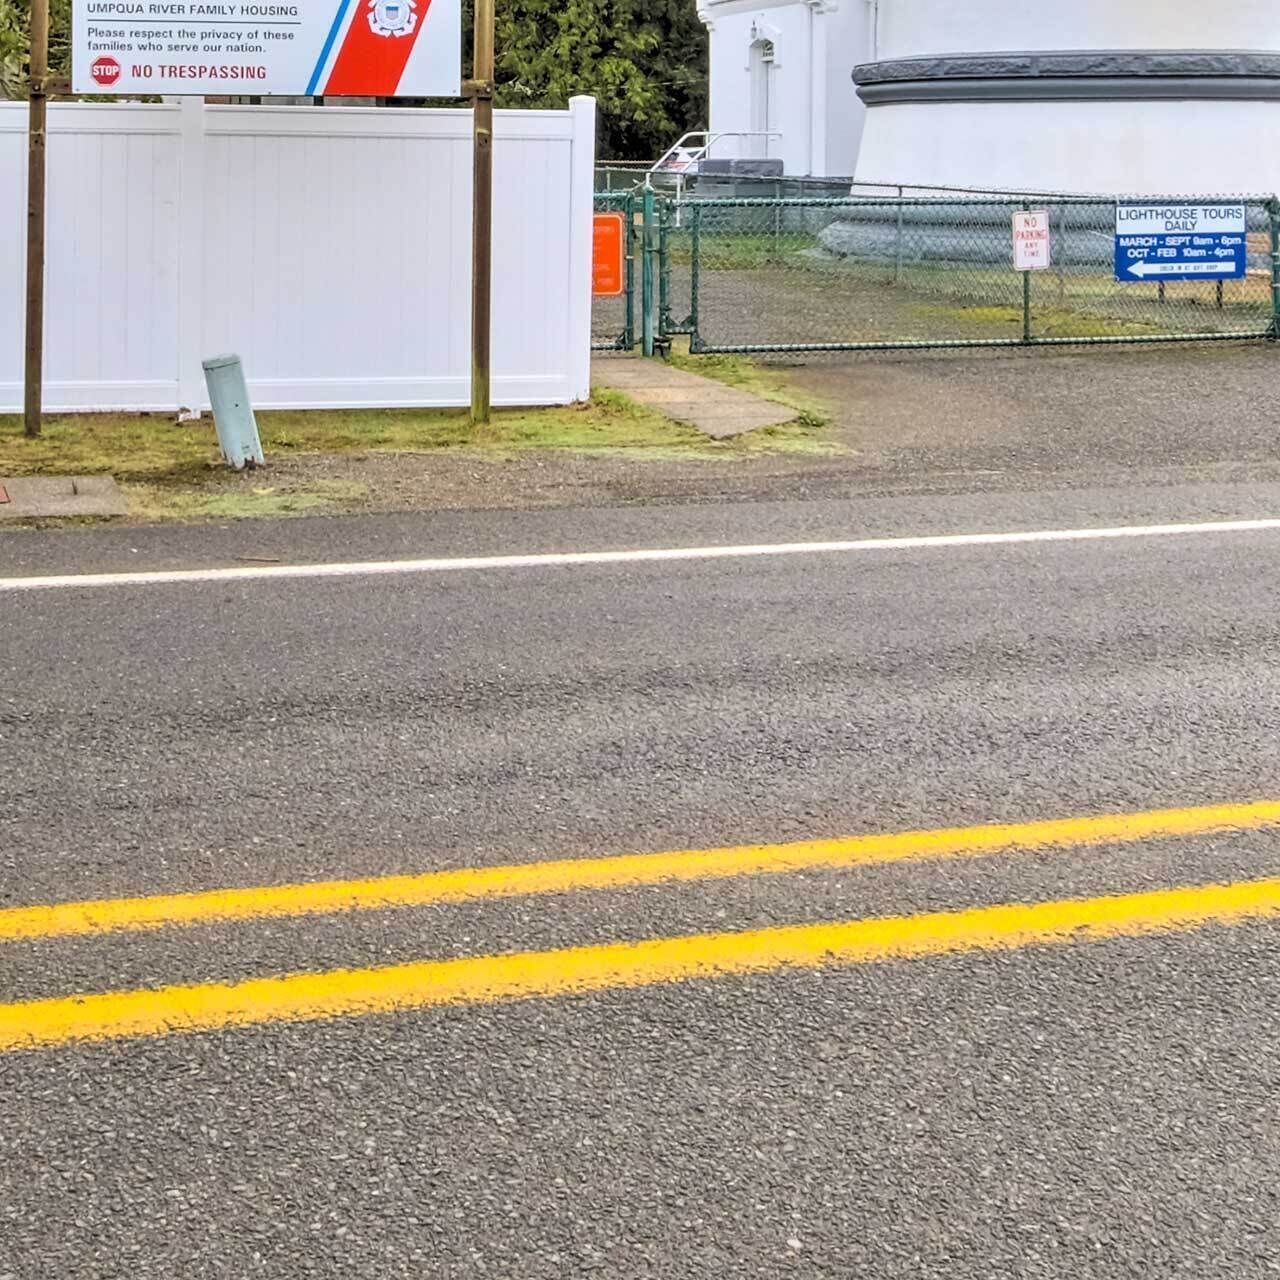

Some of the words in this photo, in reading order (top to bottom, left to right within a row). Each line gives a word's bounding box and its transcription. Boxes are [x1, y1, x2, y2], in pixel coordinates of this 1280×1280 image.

[87, 3, 144, 14] UMPQUA
[149, 4, 185, 15] RIVER
[190, 5, 236, 16] FAMILY
[240, 6, 298, 16] HOUSING
[87, 27, 125, 38] Please
[130, 29, 173, 40] respect
[178, 28, 196, 39] the
[200, 29, 243, 41] privacy
[247, 30, 259, 40] of
[263, 30, 294, 40] these
[87, 41, 133, 51] families
[138, 42, 163, 51] who
[168, 44, 199, 52] serve
[203, 44, 221, 52] our
[226, 43, 266, 53] nation.
[92, 64, 120, 76] STOP
[132, 65, 153, 78] NO
[159, 65, 266, 79] TRESPASSING
[1119, 208, 1198, 220] LIGHTHOUSE
[1202, 208, 1243, 219] TOURS
[1024, 217, 1037, 228] NO
[1164, 221, 1198, 231] DAILY
[1015, 230, 1047, 240] PARKING
[1119, 237, 1157, 246] MARCH
[1165, 236, 1191, 246] SEPT
[1221, 236, 1242, 246] 6pm
[1127, 248, 1150, 258] OCT
[1157, 248, 1177, 257] FEB
[1183, 248, 1206, 257] 10am
[1214, 248, 1235, 257] 4pm
